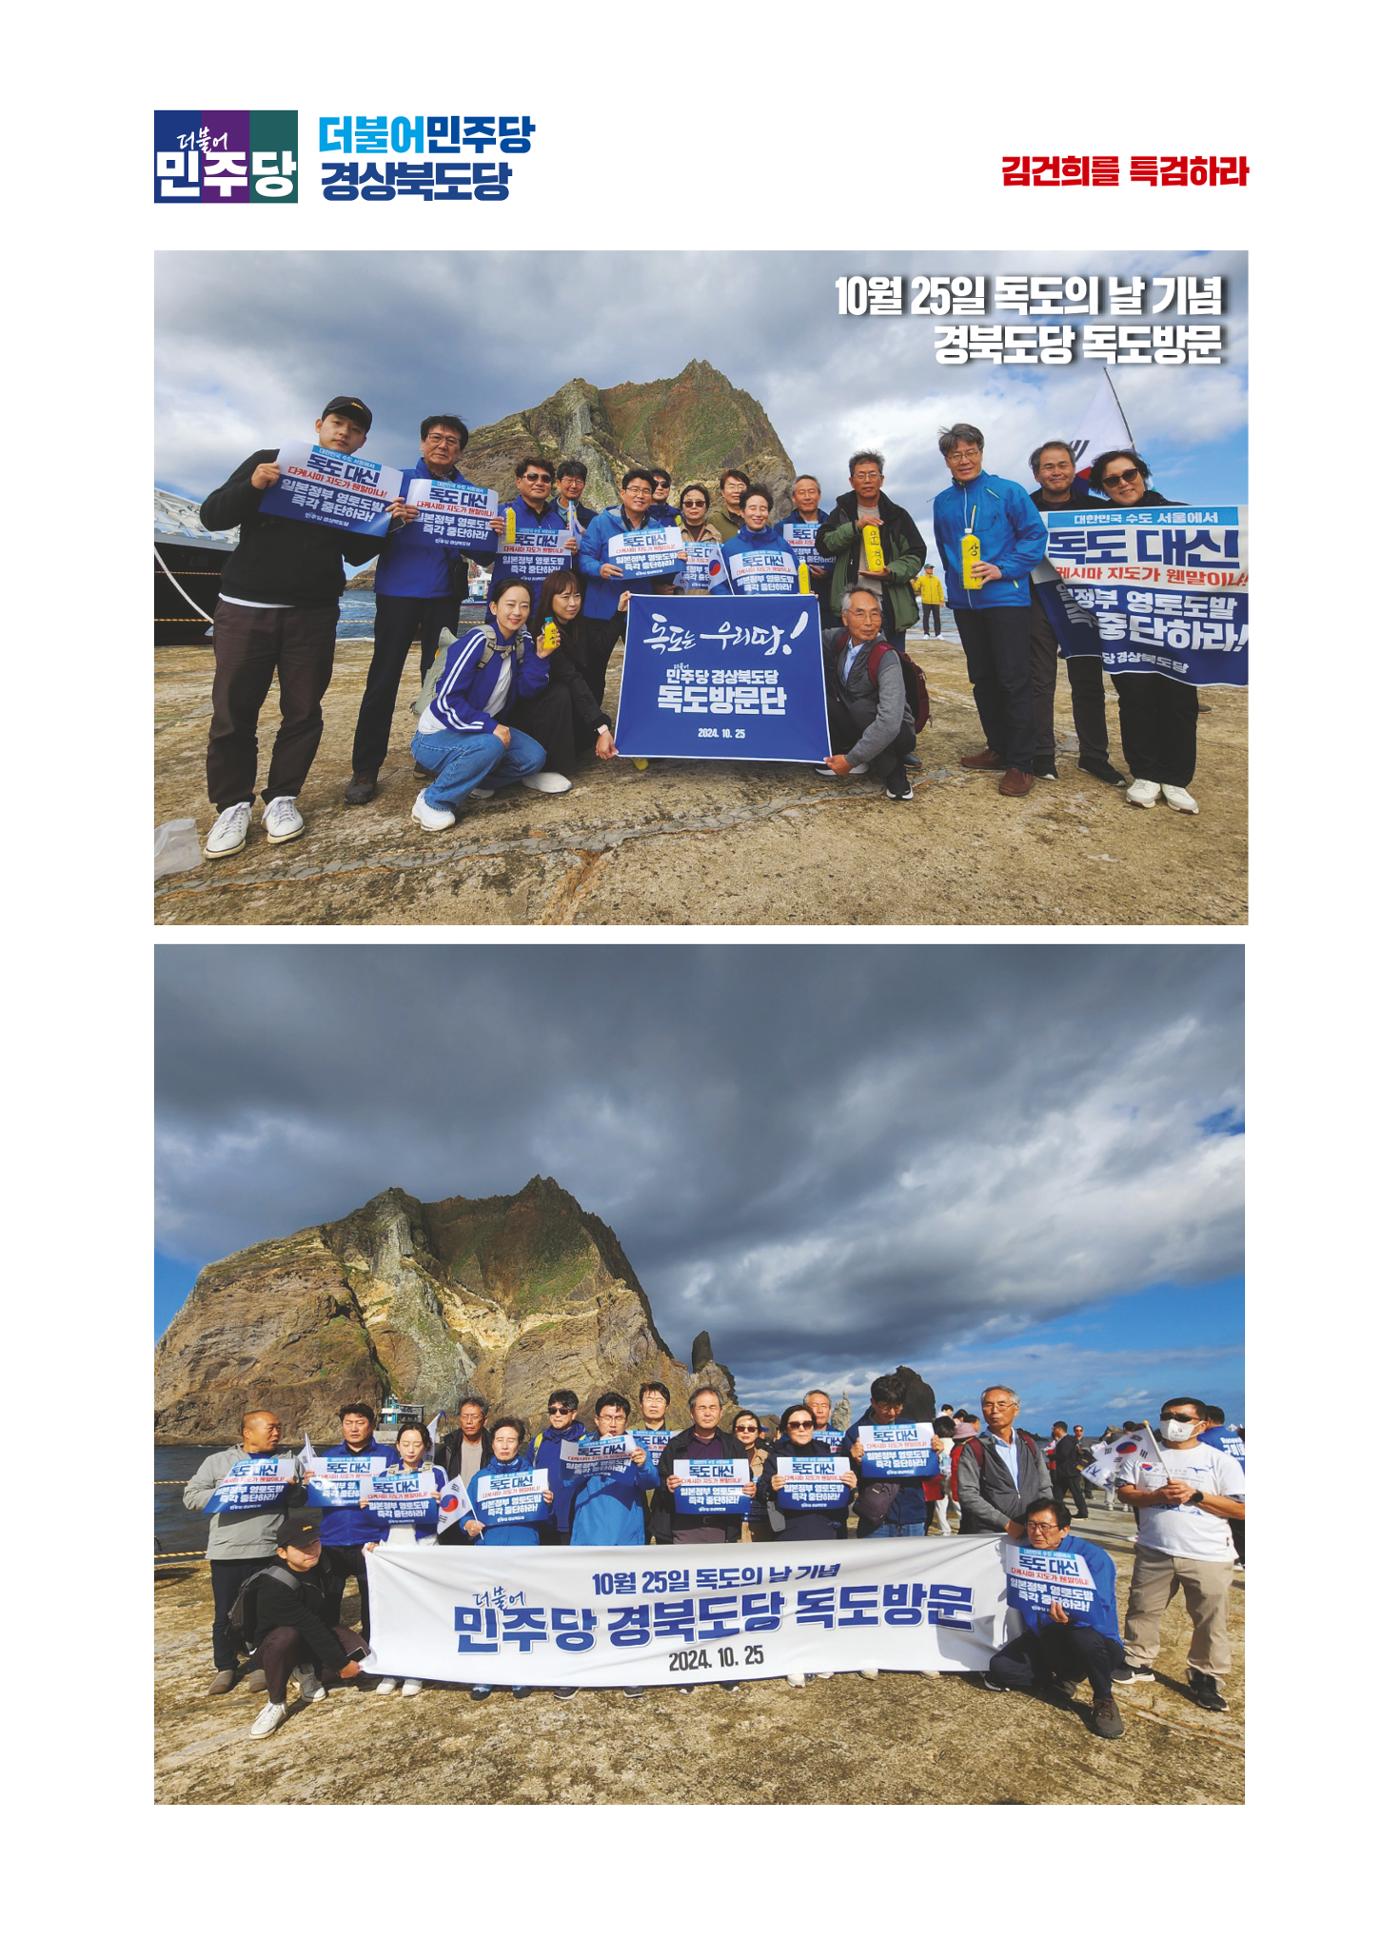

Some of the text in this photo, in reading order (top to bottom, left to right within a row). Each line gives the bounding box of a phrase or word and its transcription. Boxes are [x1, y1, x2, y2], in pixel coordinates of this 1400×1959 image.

[307, 453, 380, 487] 독도 대신
[280, 478, 385, 512] 일본정부 영토도발
[429, 488, 488, 509] 독도 대신
[291, 493, 375, 522] 즉각 중단하라!
[1074, 511, 1219, 525] 대한민국 수도 서울에서
[423, 523, 489, 540] 즉각 중단하라!
[536, 535, 558, 548] 대신
[1048, 528, 1241, 569] 독도 대신
[742, 554, 784, 567] 독도 대신
[1056, 566, 1103, 580] 케시마
[1107, 566, 1160, 583] 지도가
[1126, 590, 1238, 620] 영토도발
[643, 611, 809, 656] 독도는 우리땅!
[1095, 611, 1248, 652] 중단하라!
[666, 668, 779, 685] 민주당 경상북도당
[657, 684, 788, 716] 독도방문단
[698, 728, 746, 739] 2024. 10. 25
[873, 1429, 918, 1442] 독도 대신
[603, 1443, 626, 1455] 대신
[327, 1462, 371, 1474] 독도 대신
[689, 1465, 734, 1477] 독도 대신
[792, 1463, 836, 1475] 독도 대신
[373, 1483, 395, 1493] 독도
[396, 1480, 420, 1493] 대신
[490, 1476, 533, 1490] 독도 대신
[1019, 1555, 1080, 1577] 독도 대신
[592, 1563, 841, 1596] 10월 25일 독도의 날 기념
[472, 1586, 526, 1611] 더불어
[454, 1583, 974, 1653] 민주당 경북도당 독도방문
[669, 1645, 764, 1672] 2024. 10. 25
